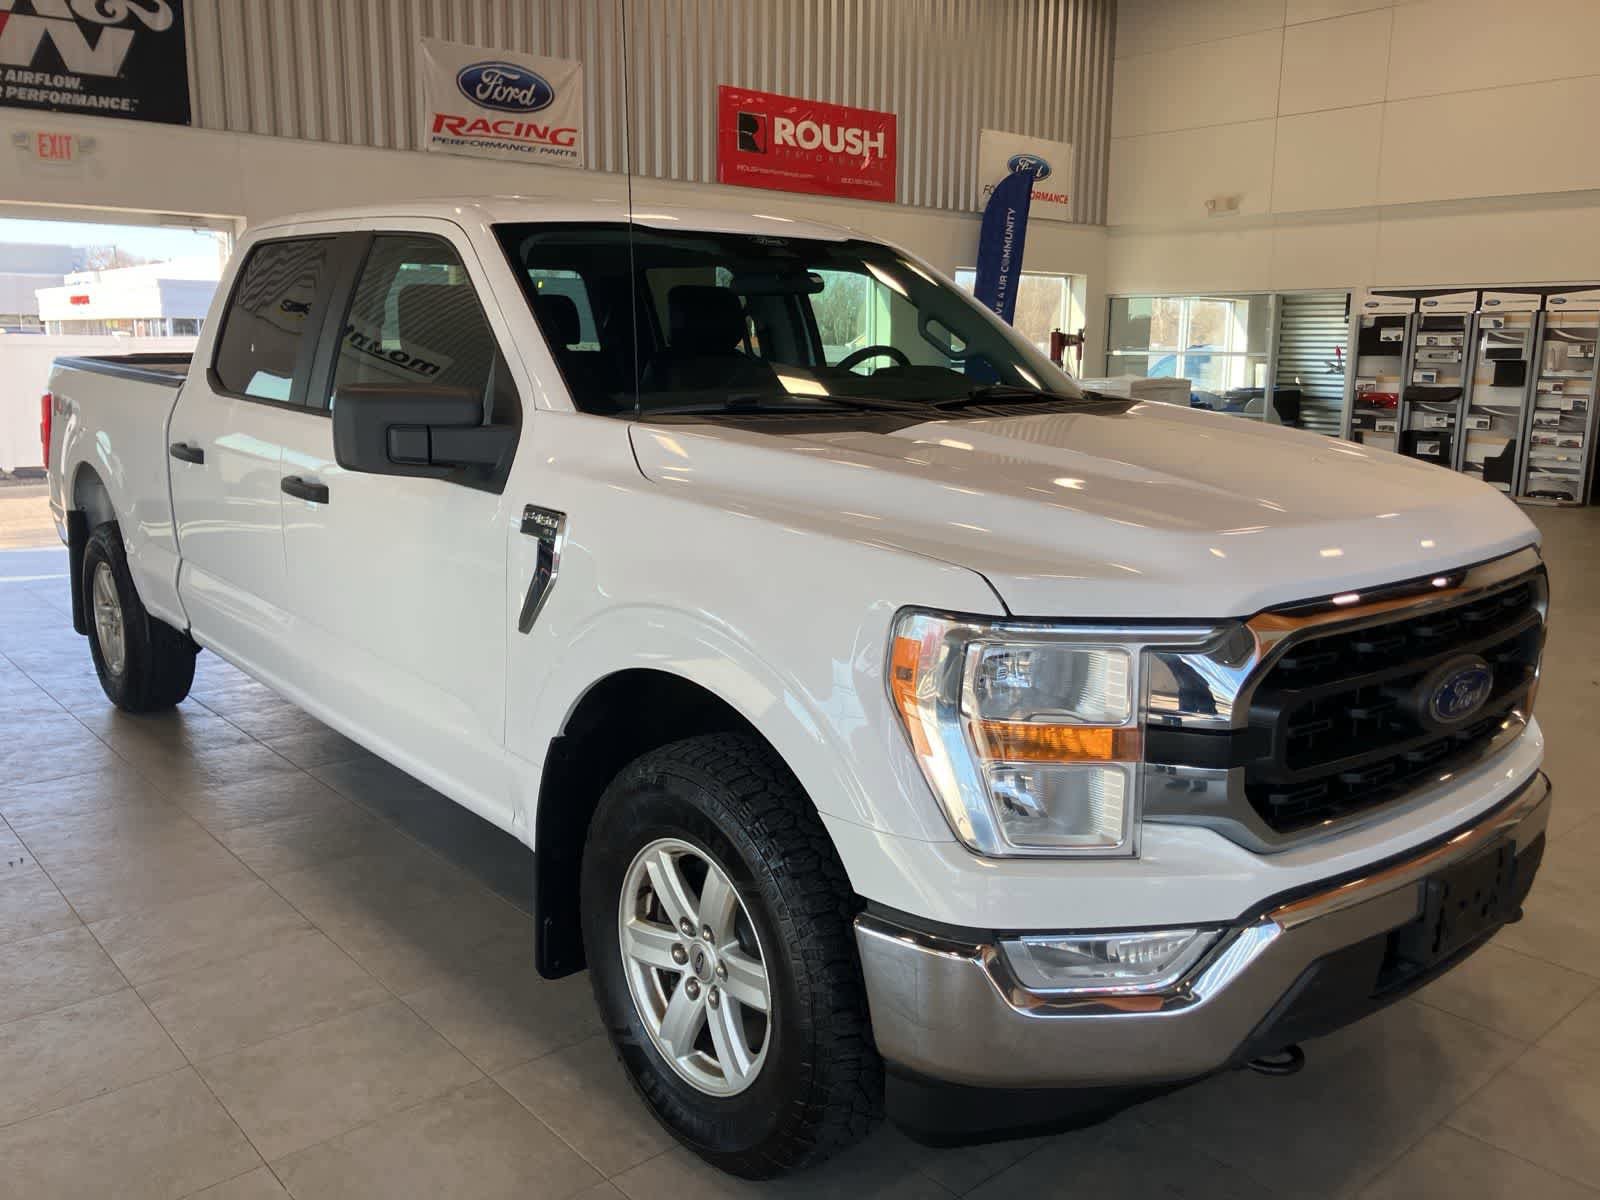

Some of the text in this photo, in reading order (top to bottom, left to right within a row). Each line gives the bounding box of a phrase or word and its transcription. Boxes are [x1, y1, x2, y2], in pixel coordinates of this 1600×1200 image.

[5, 69, 83, 90] AIRFLOW.
[476, 68, 537, 107] Ford
[432, 112, 578, 147] RACING
[774, 117, 886, 159] ROUSH
[37, 133, 72, 160] EXIT
[432, 136, 578, 158] PERFORMANCE PARTS
[1030, 190, 1069, 205] ORMANCE
[1001, 207, 1017, 273] COMMUNITY
